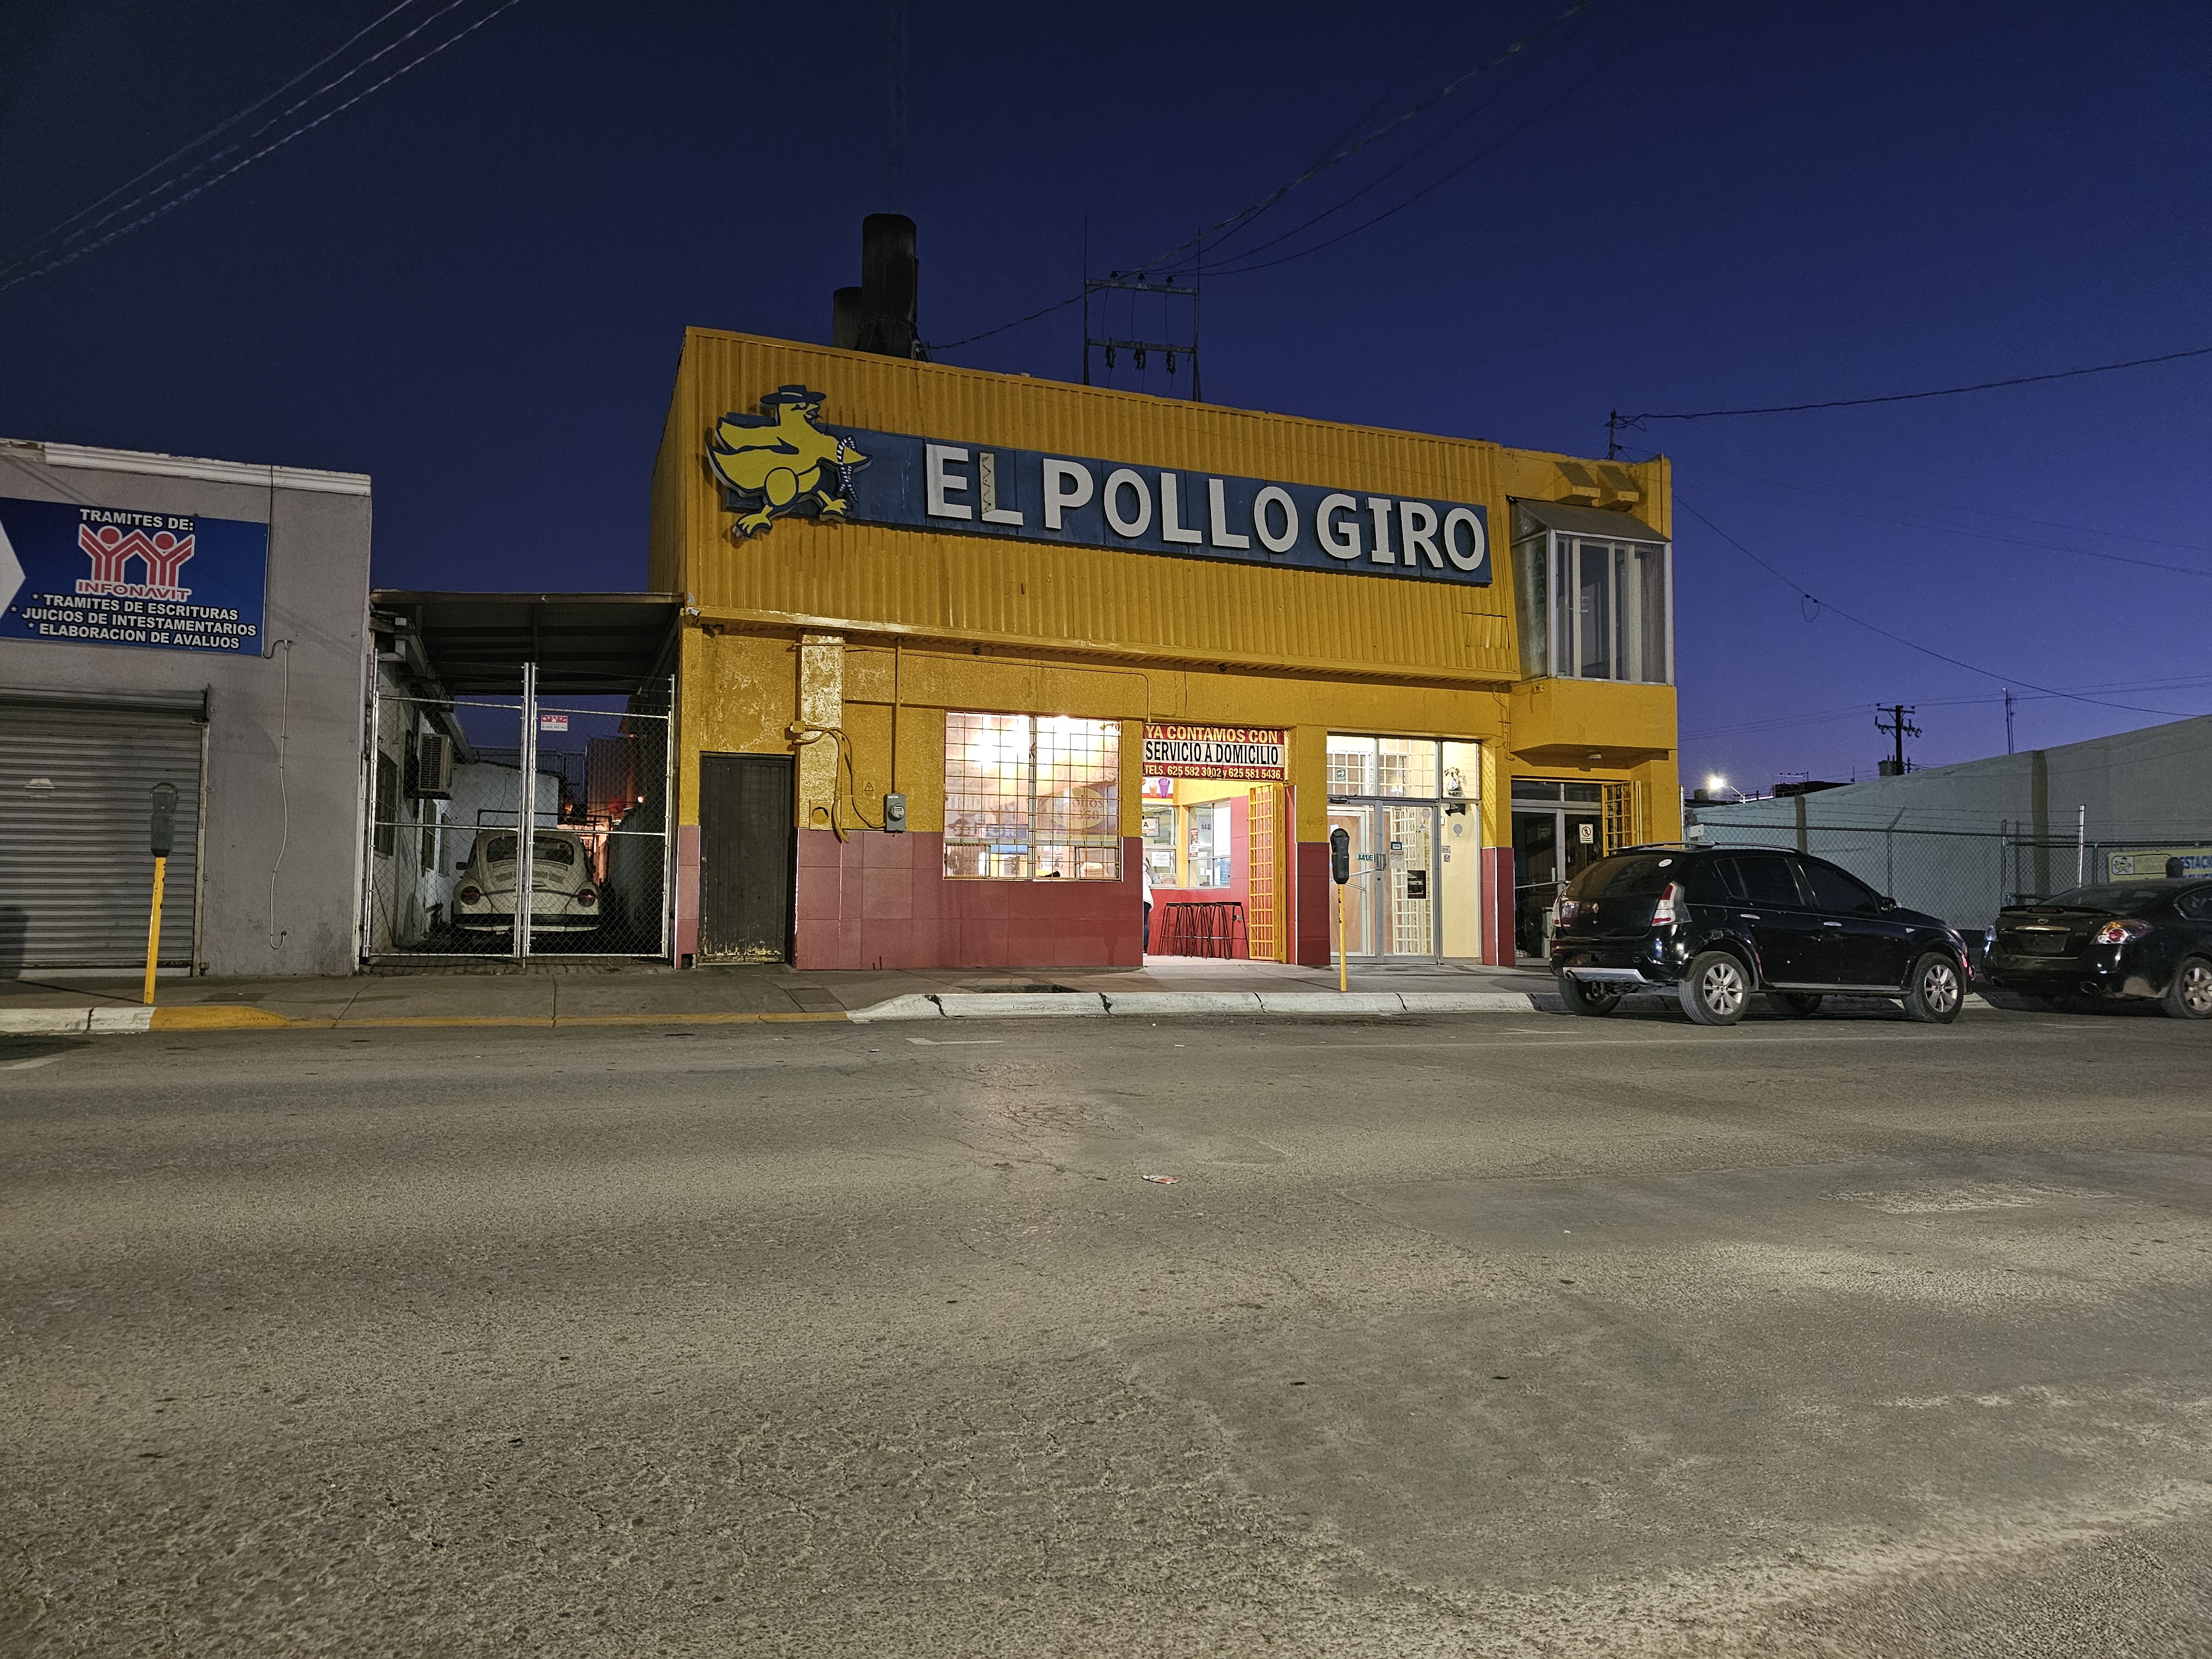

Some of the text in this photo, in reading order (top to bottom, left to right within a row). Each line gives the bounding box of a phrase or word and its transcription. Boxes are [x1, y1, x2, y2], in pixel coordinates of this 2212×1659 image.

[80, 508, 194, 531] TRAMITES DE:
[925, 443, 1485, 572] EL POLLO GIRO
[77, 581, 190, 601] INFONAVIT
[43, 593, 239, 620] TRAMITES DE ESCRITURAS
[22, 607, 257, 637] JUICIOS DE INTESTAMENTARIOS
[39, 623, 240, 649] ELABORACION DE AVALUOS
[1145, 725, 1278, 744] YA CONTAMOS CON
[1145, 740, 1279, 765] SERVICIO A DOMICILIO
[1167, 765, 1183, 776] 625
[1184, 766, 1200, 776] 582
[1201, 766, 1222, 778] 3002
[1222, 770, 1228, 779] y
[1228, 769, 1244, 778] 625
[1245, 769, 1259, 779] 581
